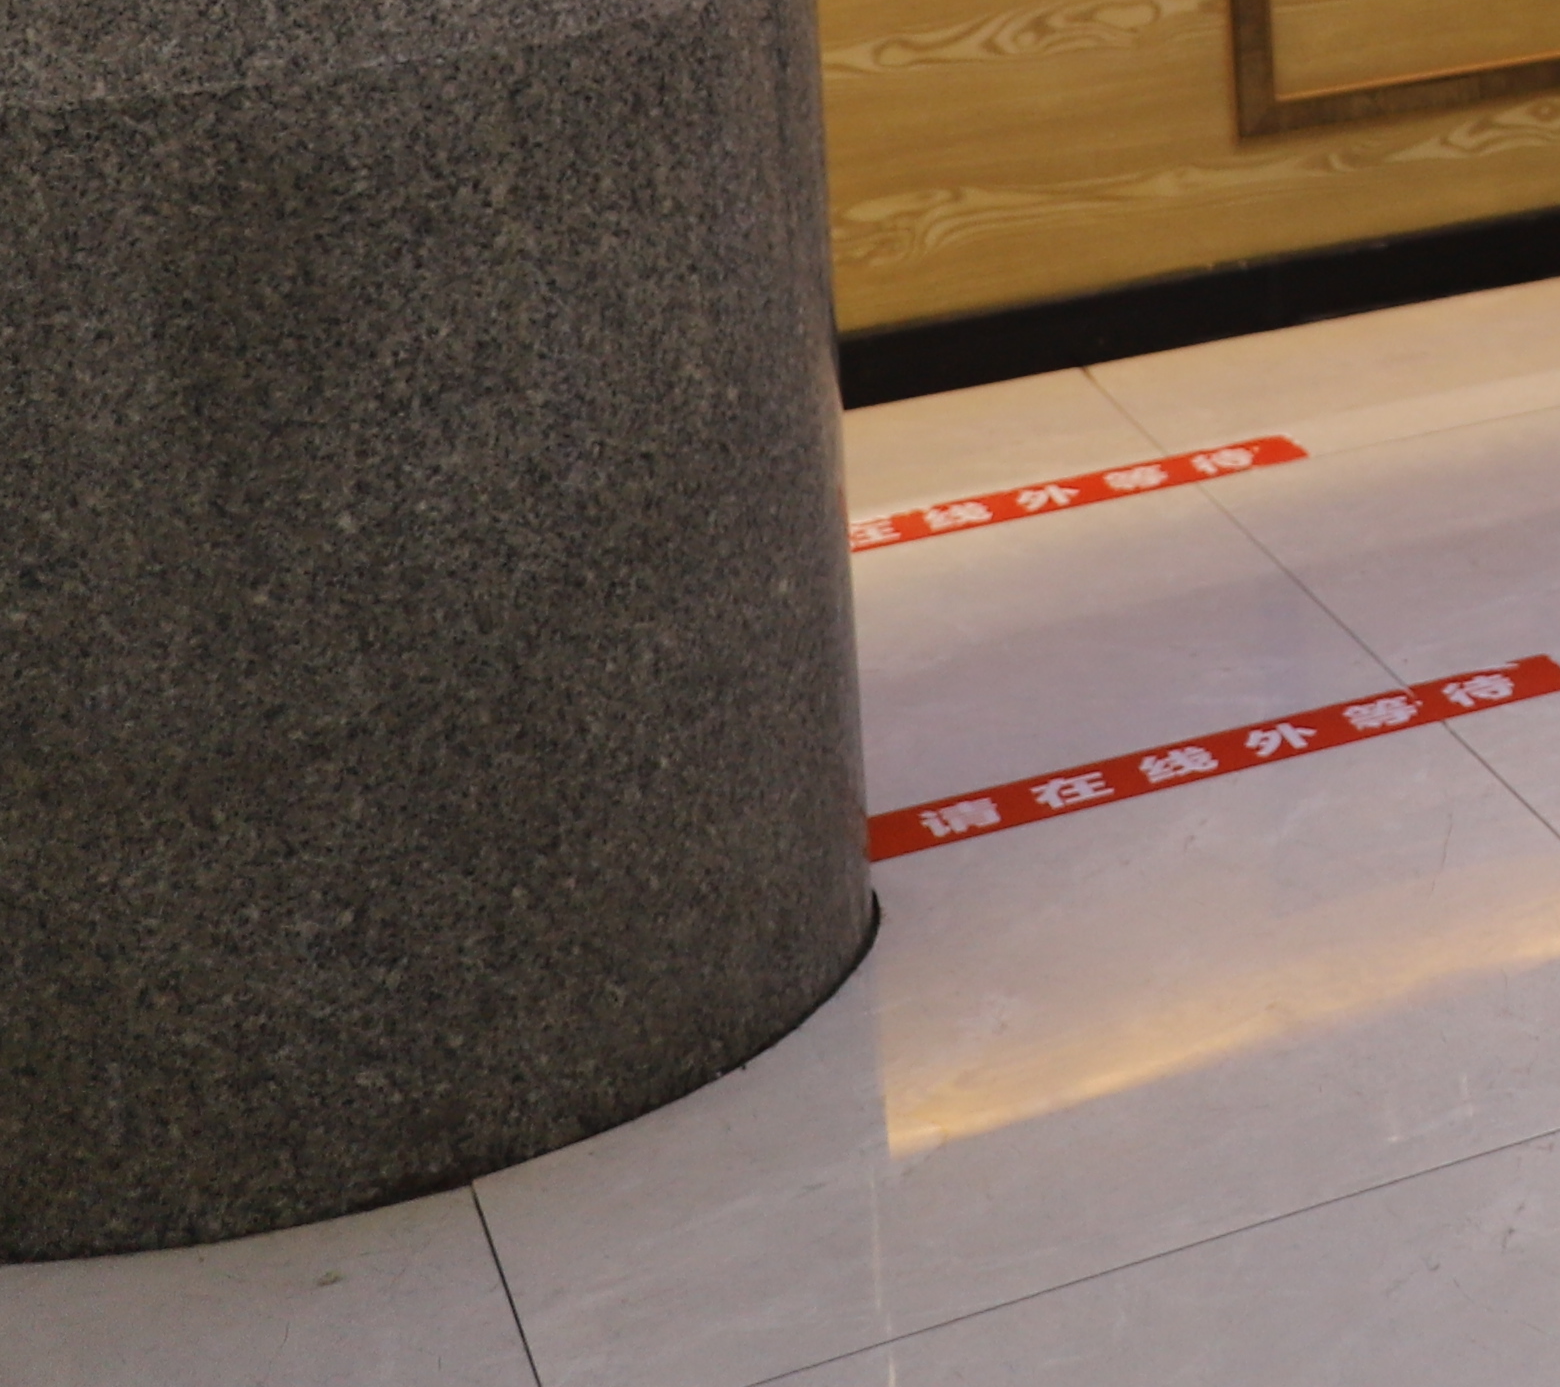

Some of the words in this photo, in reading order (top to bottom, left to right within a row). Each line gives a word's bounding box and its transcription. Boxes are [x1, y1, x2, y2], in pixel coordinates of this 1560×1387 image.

[920, 670, 1515, 838] 请在线外等待
